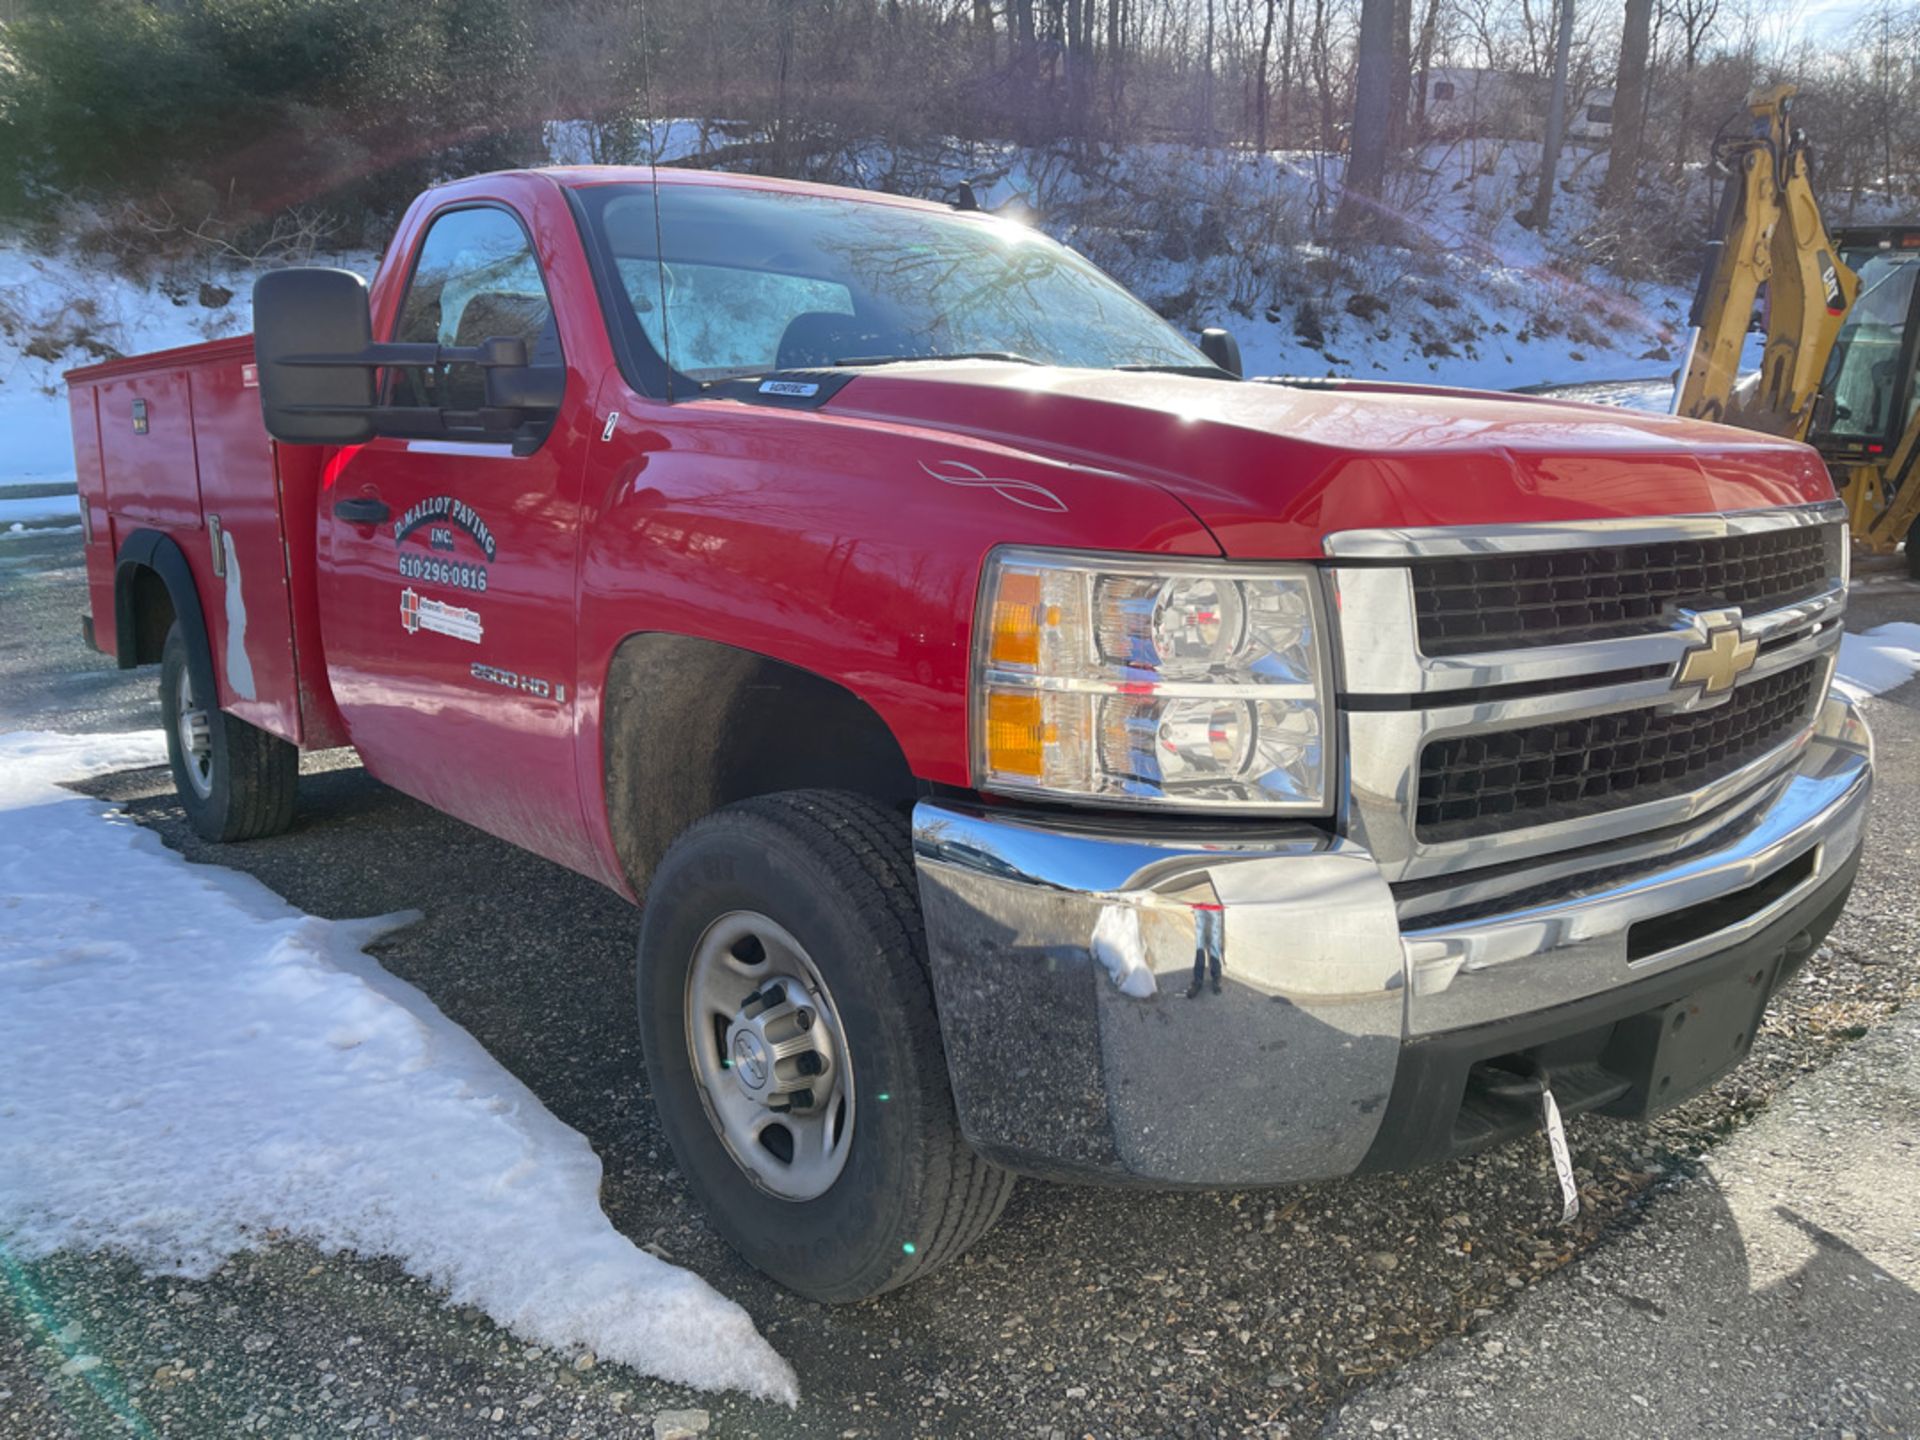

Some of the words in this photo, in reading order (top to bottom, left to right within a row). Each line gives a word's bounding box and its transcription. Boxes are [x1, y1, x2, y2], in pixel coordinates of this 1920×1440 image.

[1821, 266, 1839, 304] CAT
[431, 527, 453, 544] INC.
[452, 499, 496, 554] PAVING
